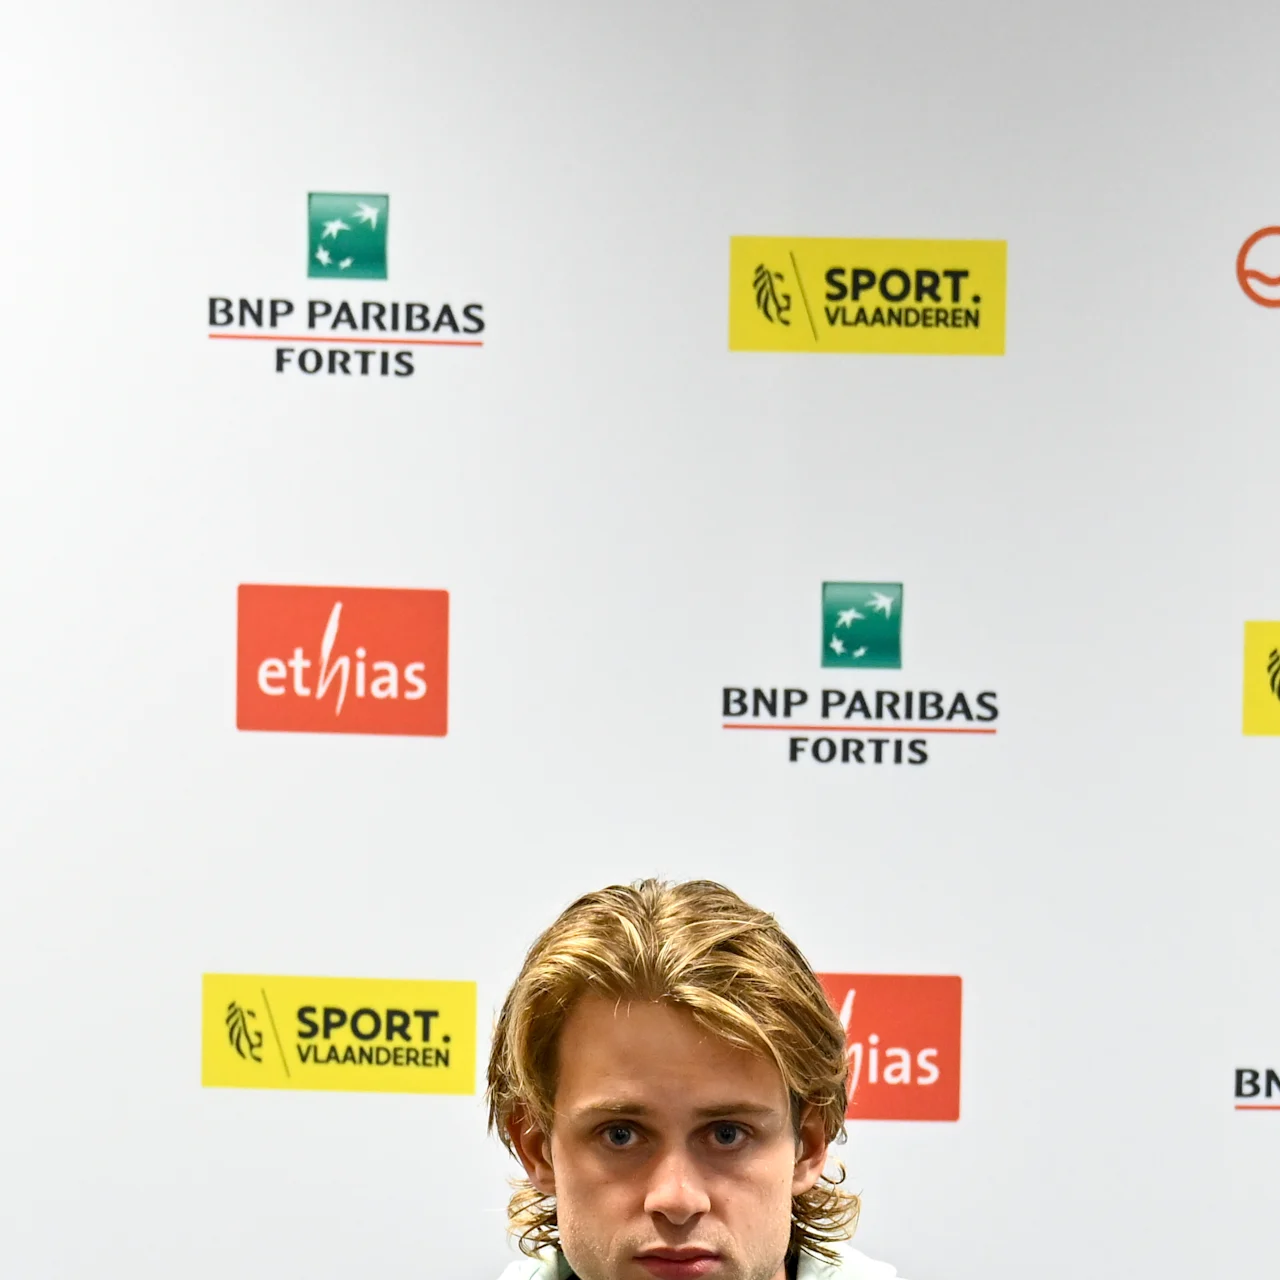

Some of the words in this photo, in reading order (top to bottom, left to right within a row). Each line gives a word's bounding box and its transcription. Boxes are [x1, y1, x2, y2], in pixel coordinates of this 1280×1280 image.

[824, 266, 981, 305] SPORT.
[208, 297, 295, 328] BNP
[307, 299, 486, 335] PARIBAS
[824, 305, 980, 329] VLAANDEREN
[275, 347, 415, 378] FORTIS
[257, 601, 427, 714] ethias
[722, 687, 809, 718] BNP
[821, 689, 999, 722] PARIBAS
[789, 737, 929, 766] FORTIS
[296, 1005, 451, 1044] SPORT.
[296, 1043, 450, 1068] VLAANDEREN
